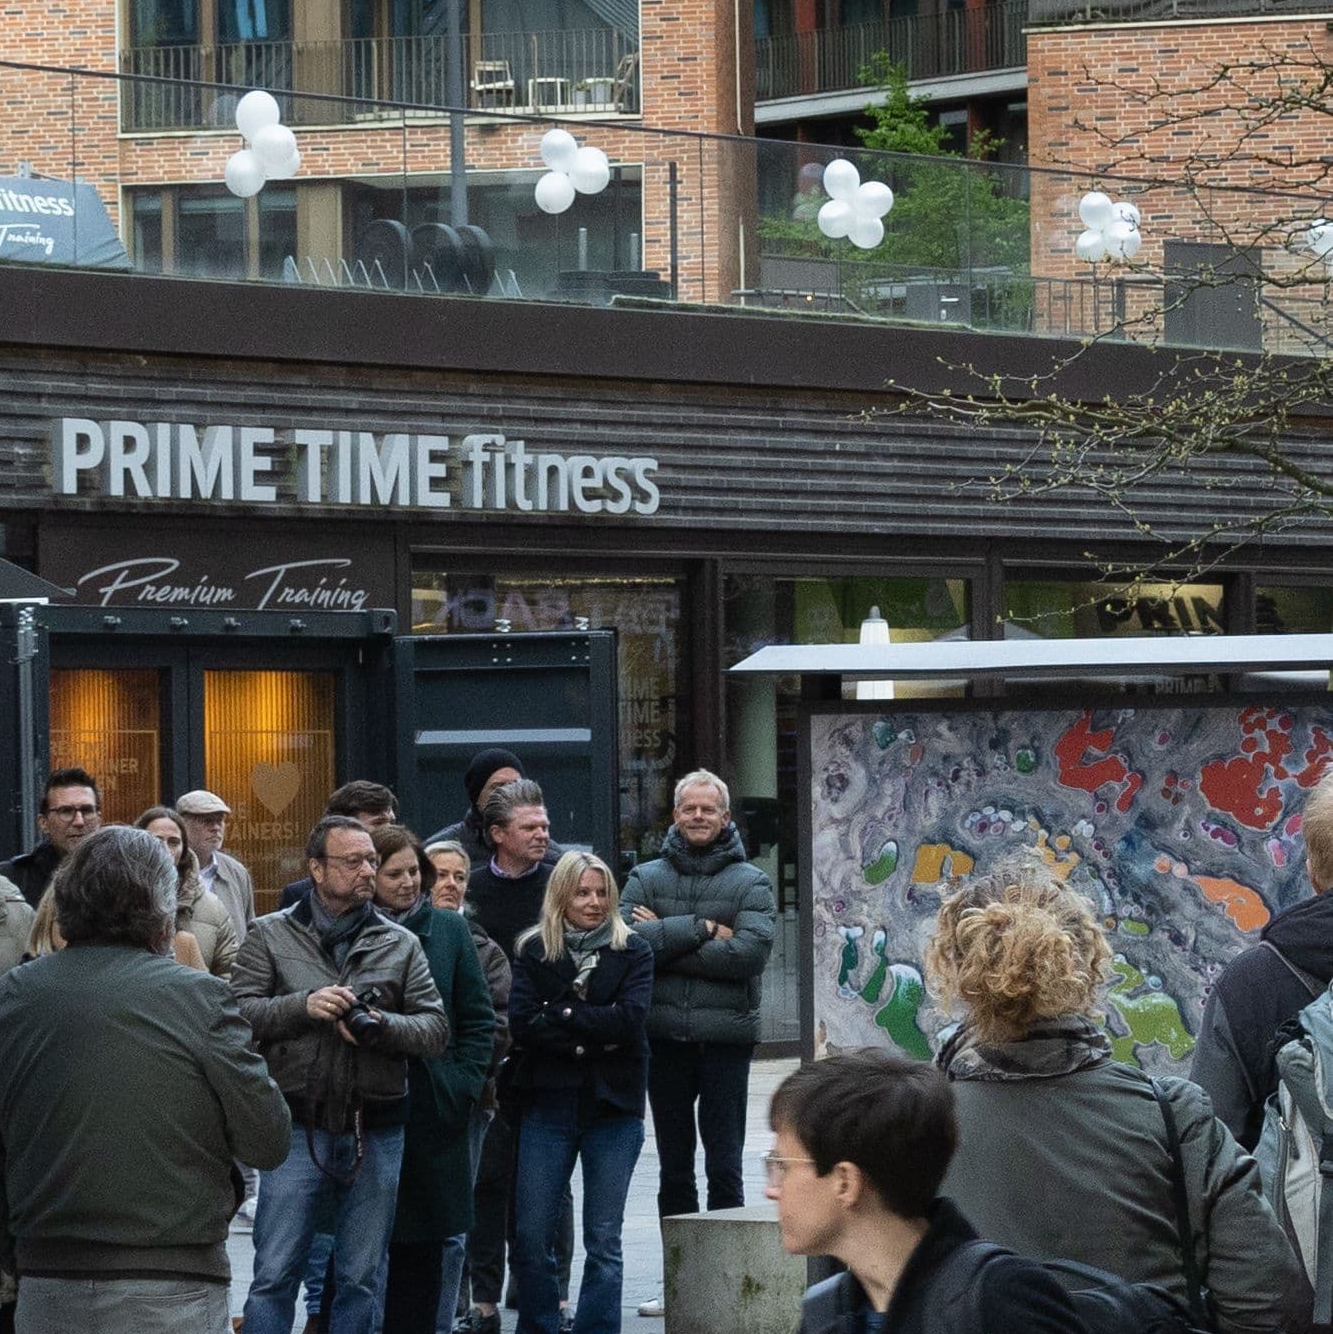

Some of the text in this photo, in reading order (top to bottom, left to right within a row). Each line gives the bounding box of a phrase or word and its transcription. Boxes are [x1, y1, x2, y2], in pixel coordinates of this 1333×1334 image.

[60, 417, 660, 515] PRIME TIME fitness
[77, 557, 370, 611] Premium Training
